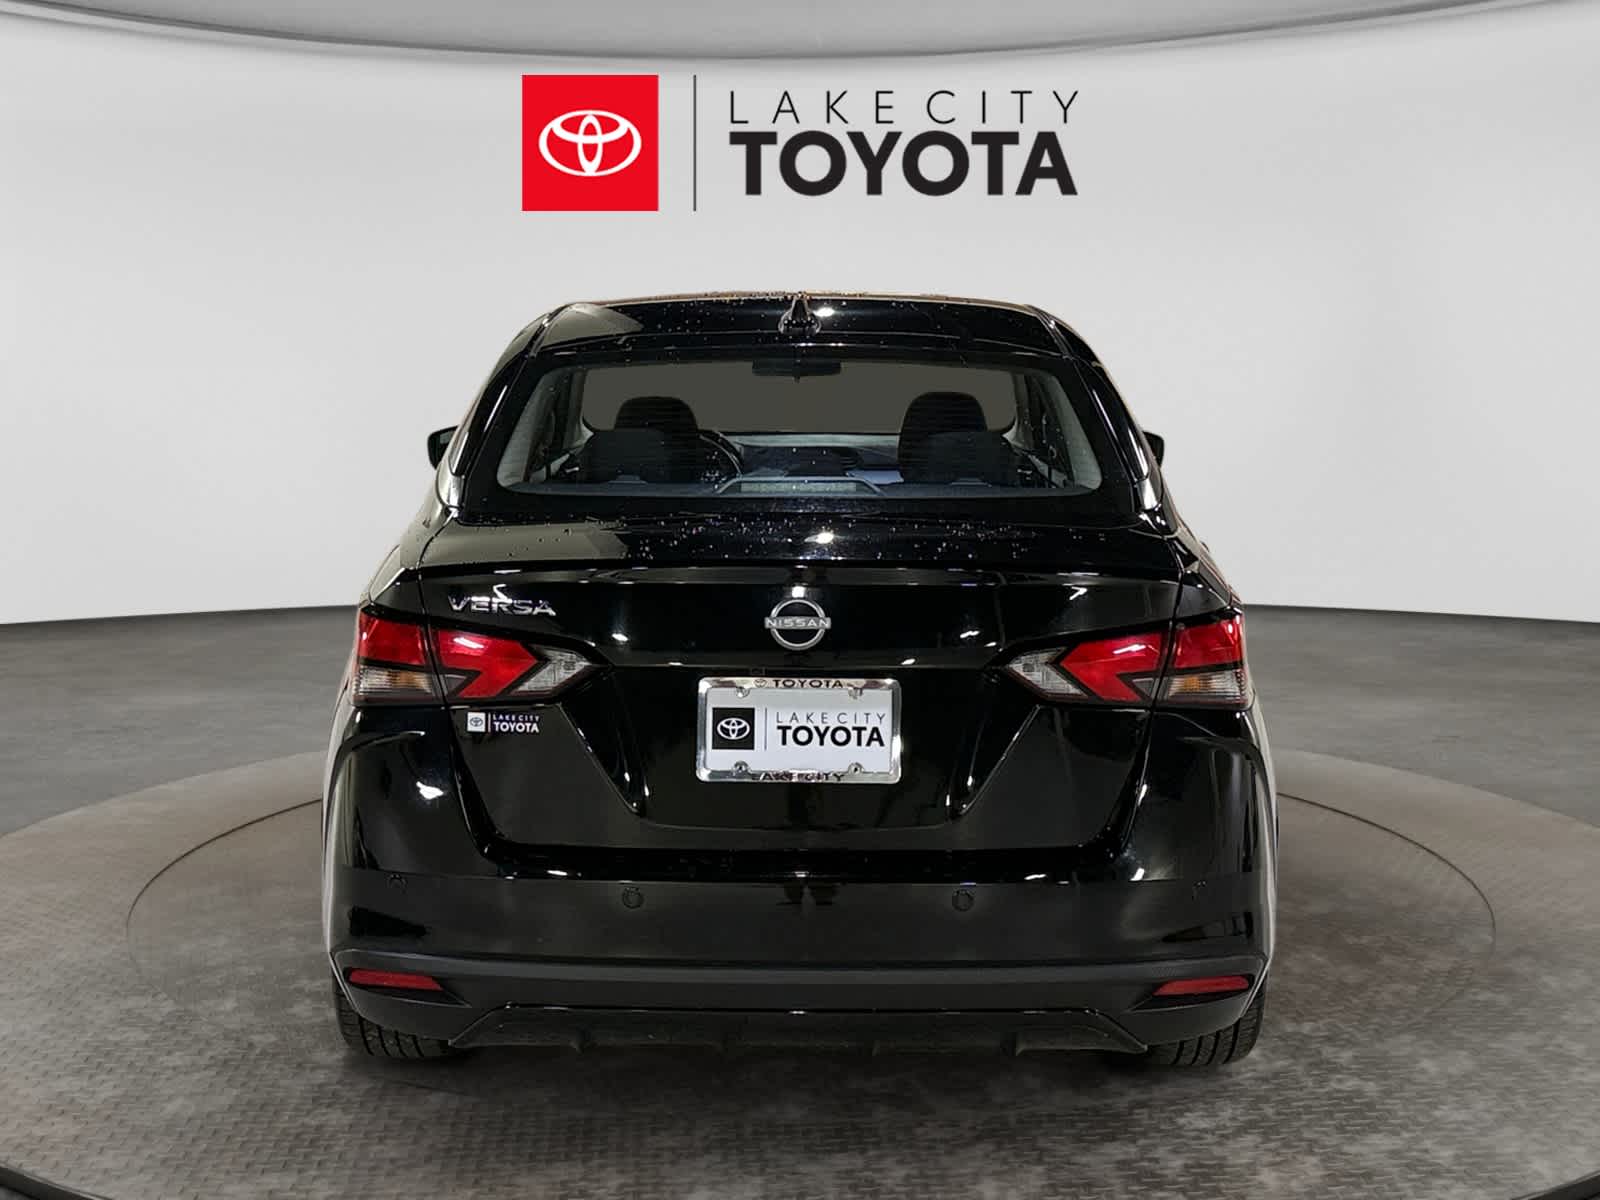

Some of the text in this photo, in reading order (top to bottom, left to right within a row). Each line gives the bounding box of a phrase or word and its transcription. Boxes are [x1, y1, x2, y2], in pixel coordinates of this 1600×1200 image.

[448, 595, 556, 616] VERSA
[766, 618, 829, 628] NISSAN
[773, 679, 843, 688] TOYOTA
[776, 712, 886, 724] LAKE CITY
[494, 721, 539, 733] TOYOTA
[777, 725, 885, 747] TOYOTA
